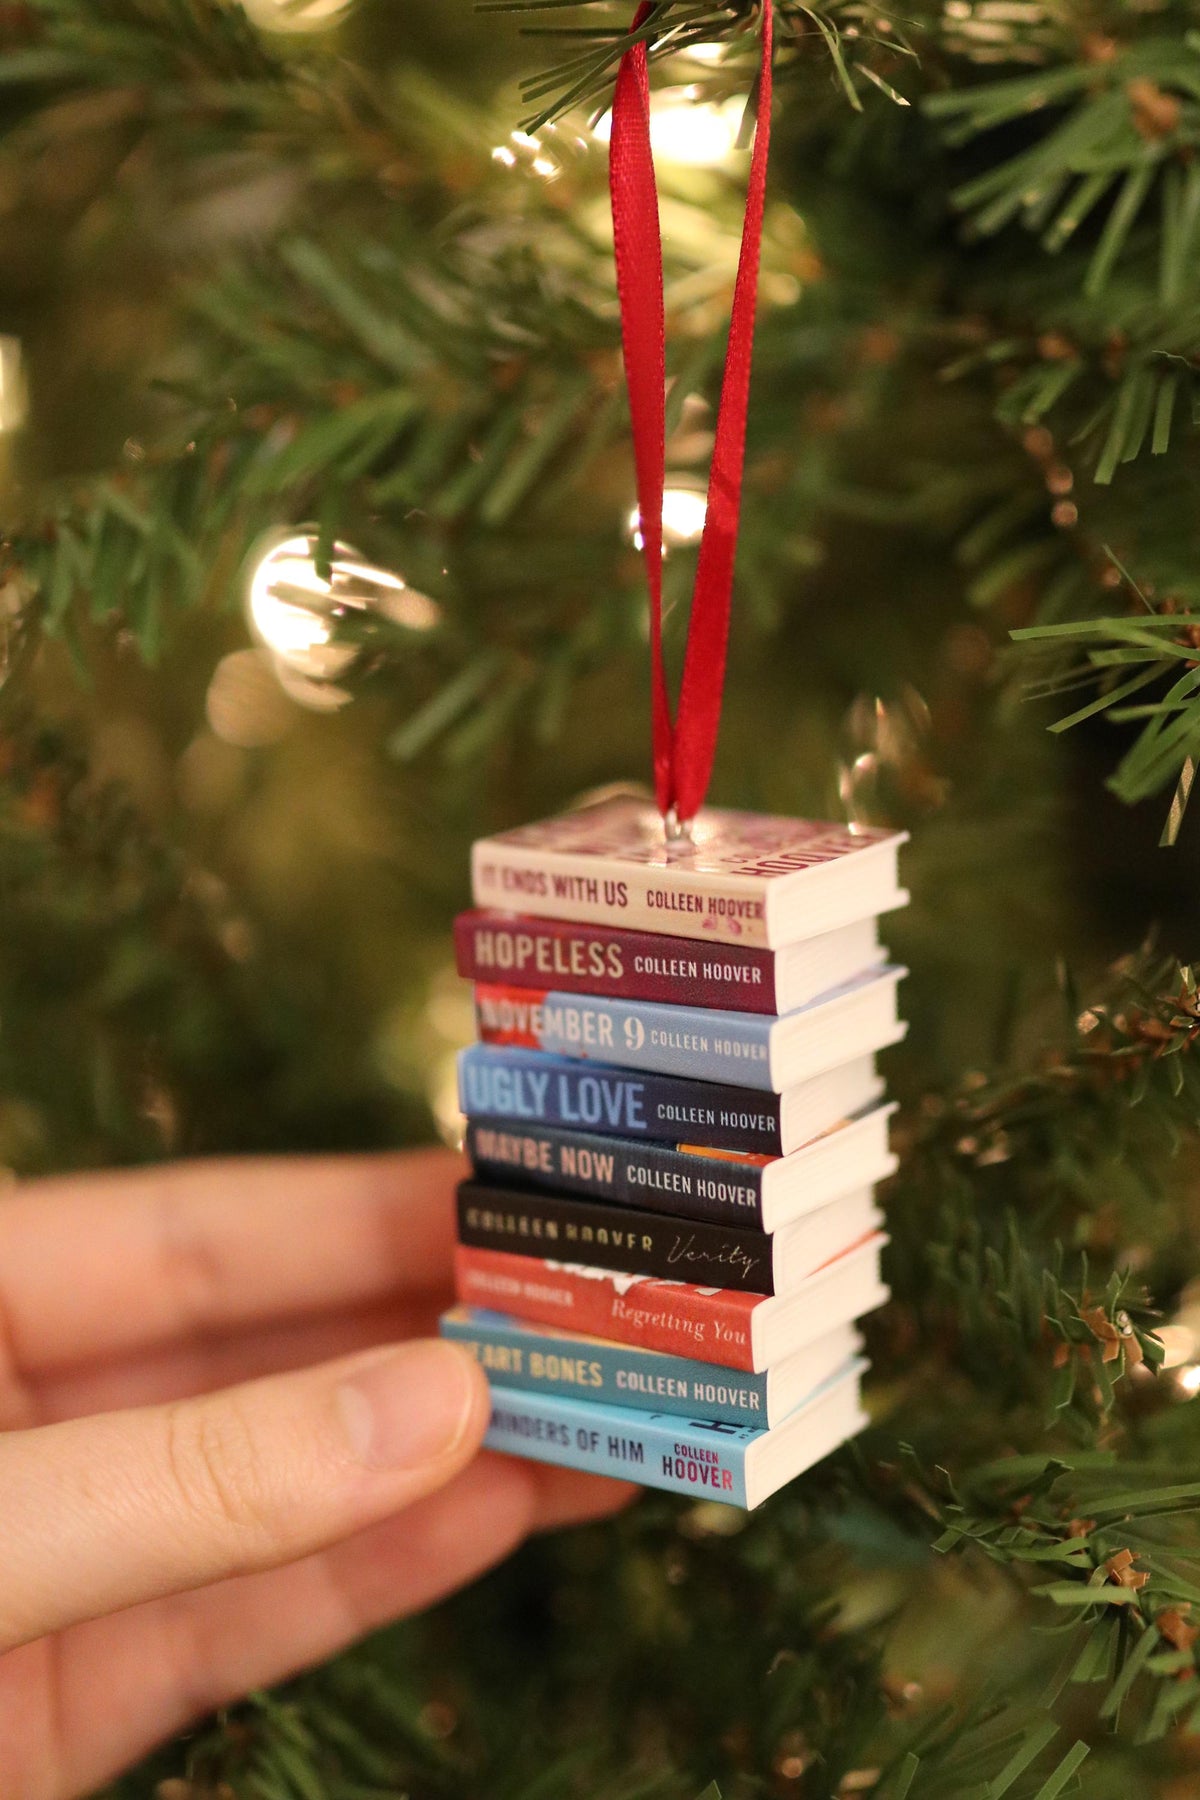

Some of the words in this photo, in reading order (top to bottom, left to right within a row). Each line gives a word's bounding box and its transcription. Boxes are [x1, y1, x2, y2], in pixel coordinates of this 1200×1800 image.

[502, 866, 548, 897] ENDS
[552, 874, 598, 903] WITH
[604, 880, 629, 908] US
[647, 890, 703, 913] COLLEEN
[708, 897, 764, 920] HOOVER
[475, 930, 624, 979] HOPELESS
[634, 956, 697, 979] COLLEEN
[703, 962, 761, 984] HOOVER
[482, 999, 614, 1048] NOVEMBER
[624, 1017, 645, 1050] 9
[651, 1030, 709, 1053] COLLEEN
[714, 1040, 767, 1060] HOOVER
[466, 1065, 549, 1118] UGLY
[559, 1075, 647, 1129] LOVE
[657, 1104, 715, 1125] COLLEEN
[720, 1111, 776, 1132] HOOVER
[475, 1128, 554, 1173] MAYBE
[561, 1146, 614, 1184] NOW
[627, 1165, 692, 1194] COLLEEN
[697, 1179, 757, 1208] HOOVER
[667, 1234, 760, 1279] Verity
[611, 1298, 706, 1341] Regretting
[714, 1320, 747, 1345] You
[529, 1352, 604, 1387] BONES
[616, 1370, 688, 1398] COLLEEN
[694, 1383, 760, 1411] HOOVER
[576, 1428, 599, 1453] OF
[608, 1435, 645, 1464] HIM
[674, 1443, 719, 1465] COLLEEN
[662, 1456, 734, 1492] HOOVER
